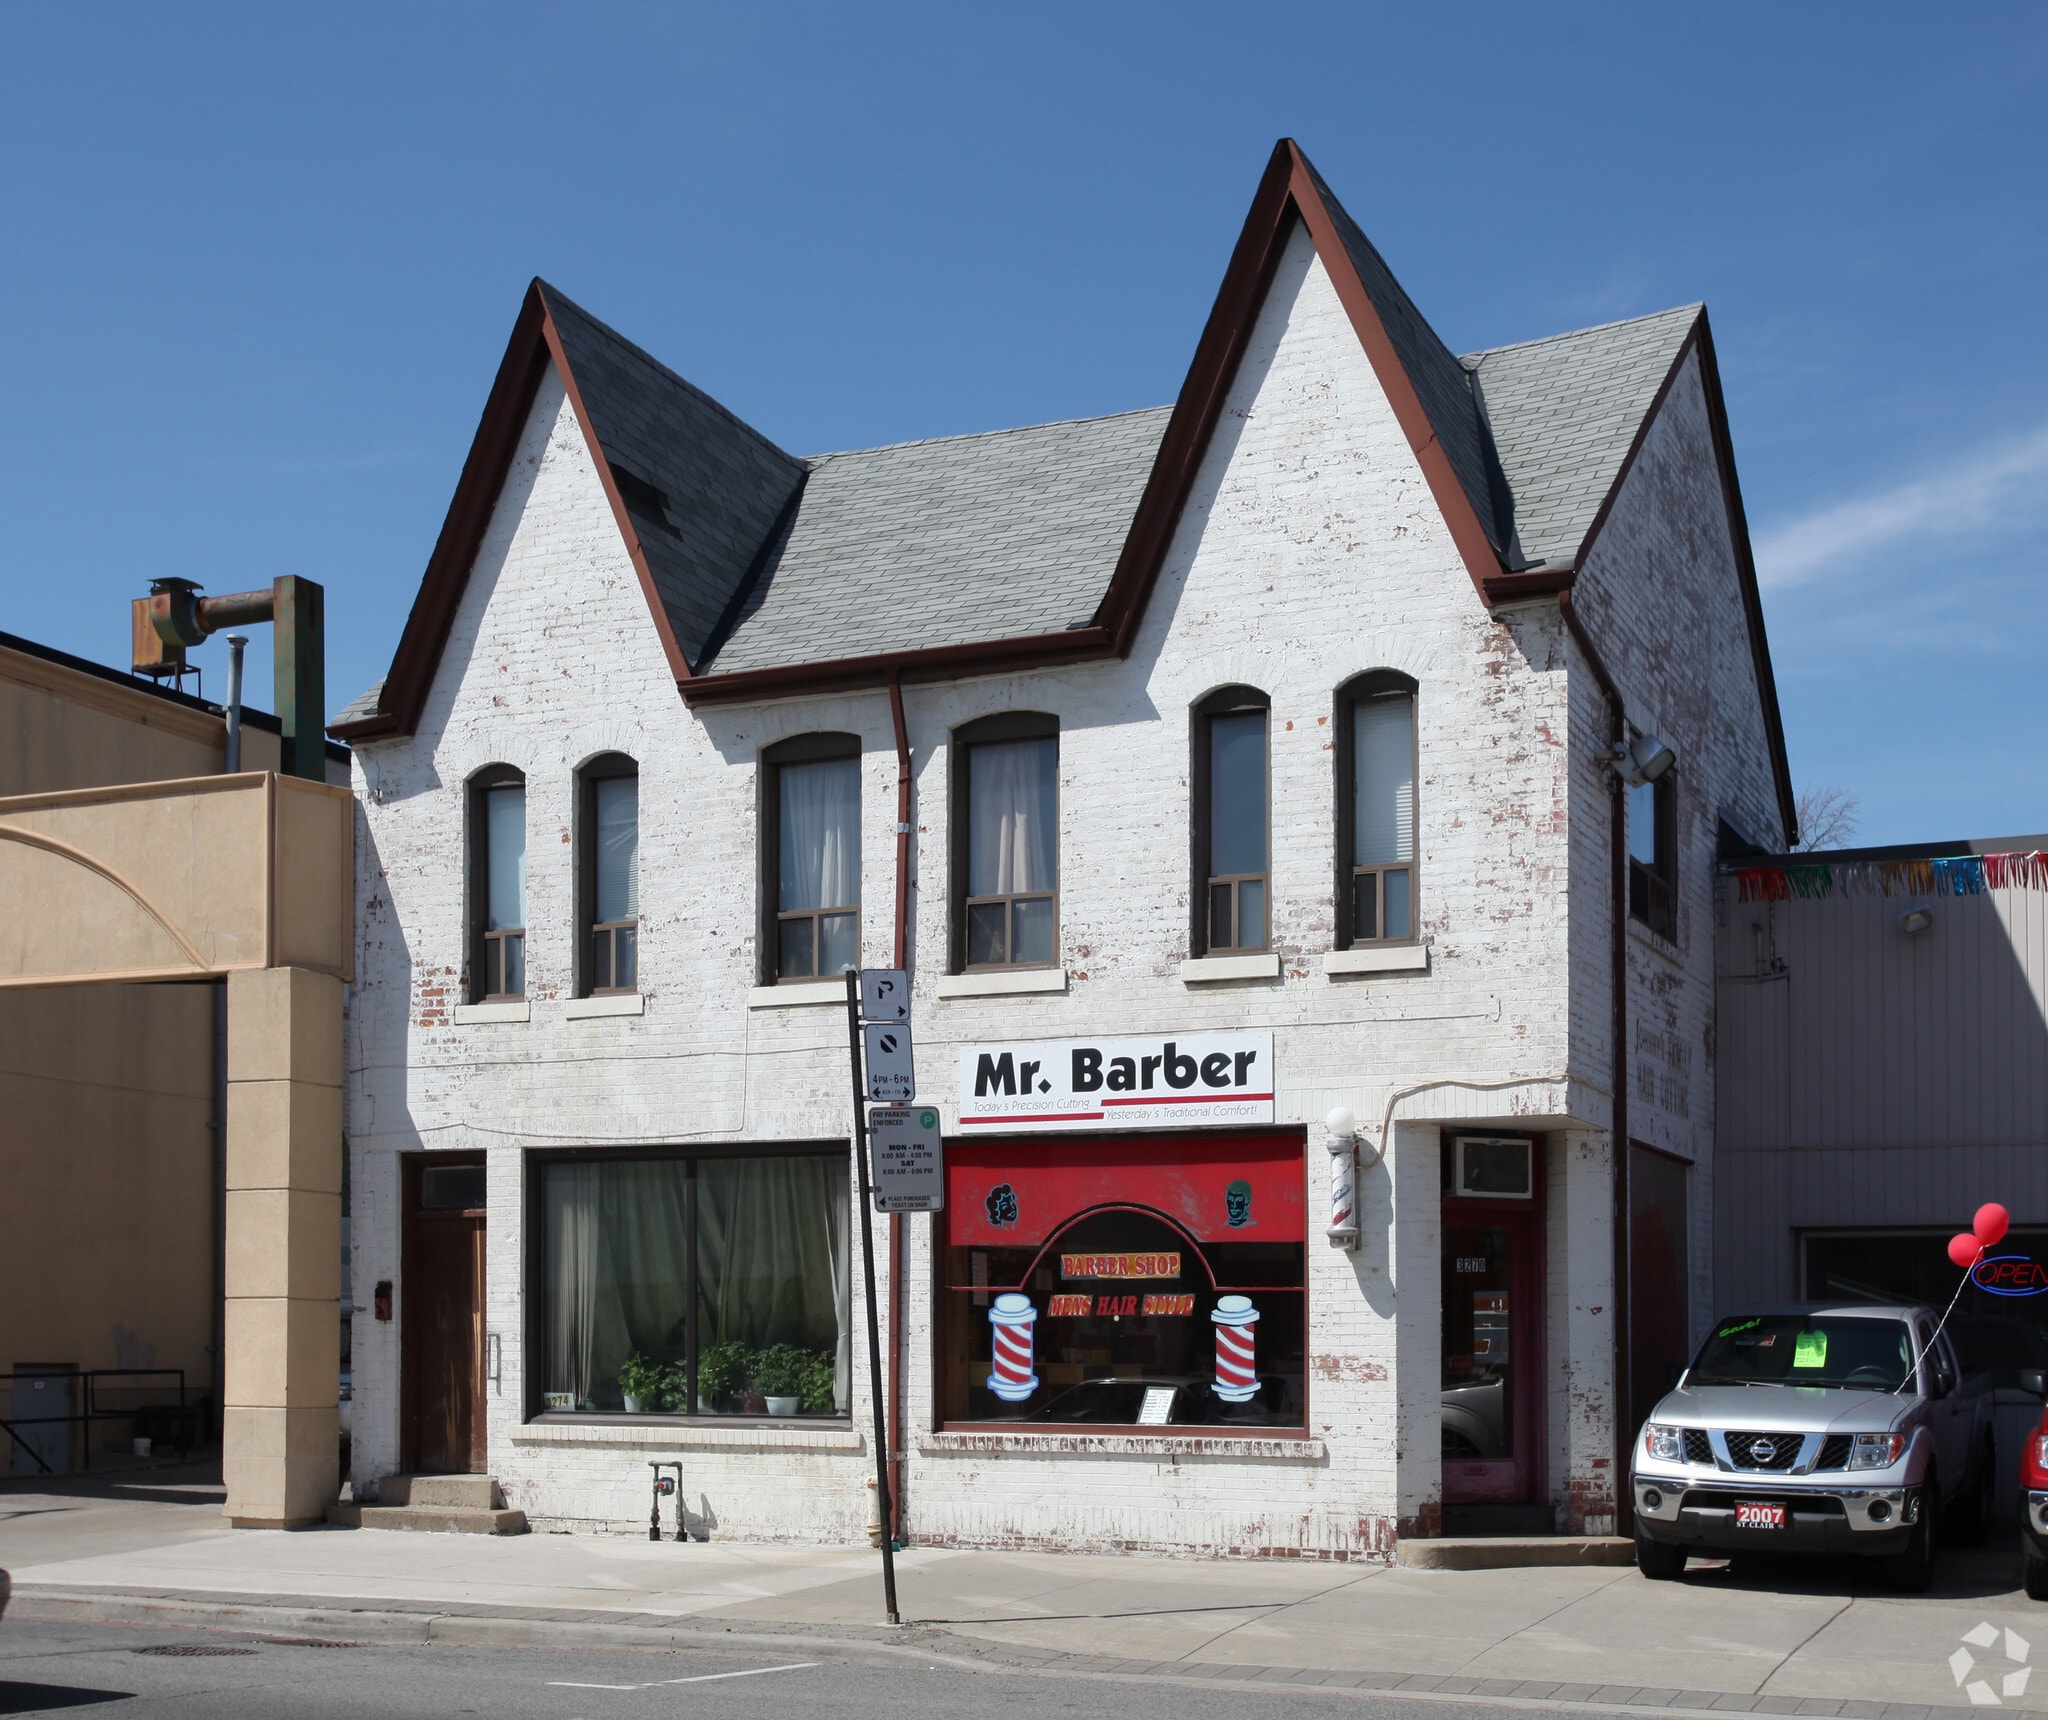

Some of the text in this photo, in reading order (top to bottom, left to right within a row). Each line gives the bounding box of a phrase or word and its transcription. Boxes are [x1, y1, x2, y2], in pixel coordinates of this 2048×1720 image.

[974, 1042, 1257, 1097] Mr. Barber
[974, 1101, 1009, 1113] Today's
[1012, 1100, 1053, 1111] Precision
[1107, 1105, 1257, 1120] Yesterday's Traditional Comfort!
[924, 1115, 932, 1125] P
[1063, 1255, 1179, 1276] BARBER SHOP
[1457, 1258, 1485, 1272] 3270
[1976, 1263, 2048, 1284] OPEN
[1050, 1295, 1195, 1316] MENS HAIR STYLE
[546, 1395, 568, 1408] 3274
[1740, 1507, 1783, 1524] 2007
